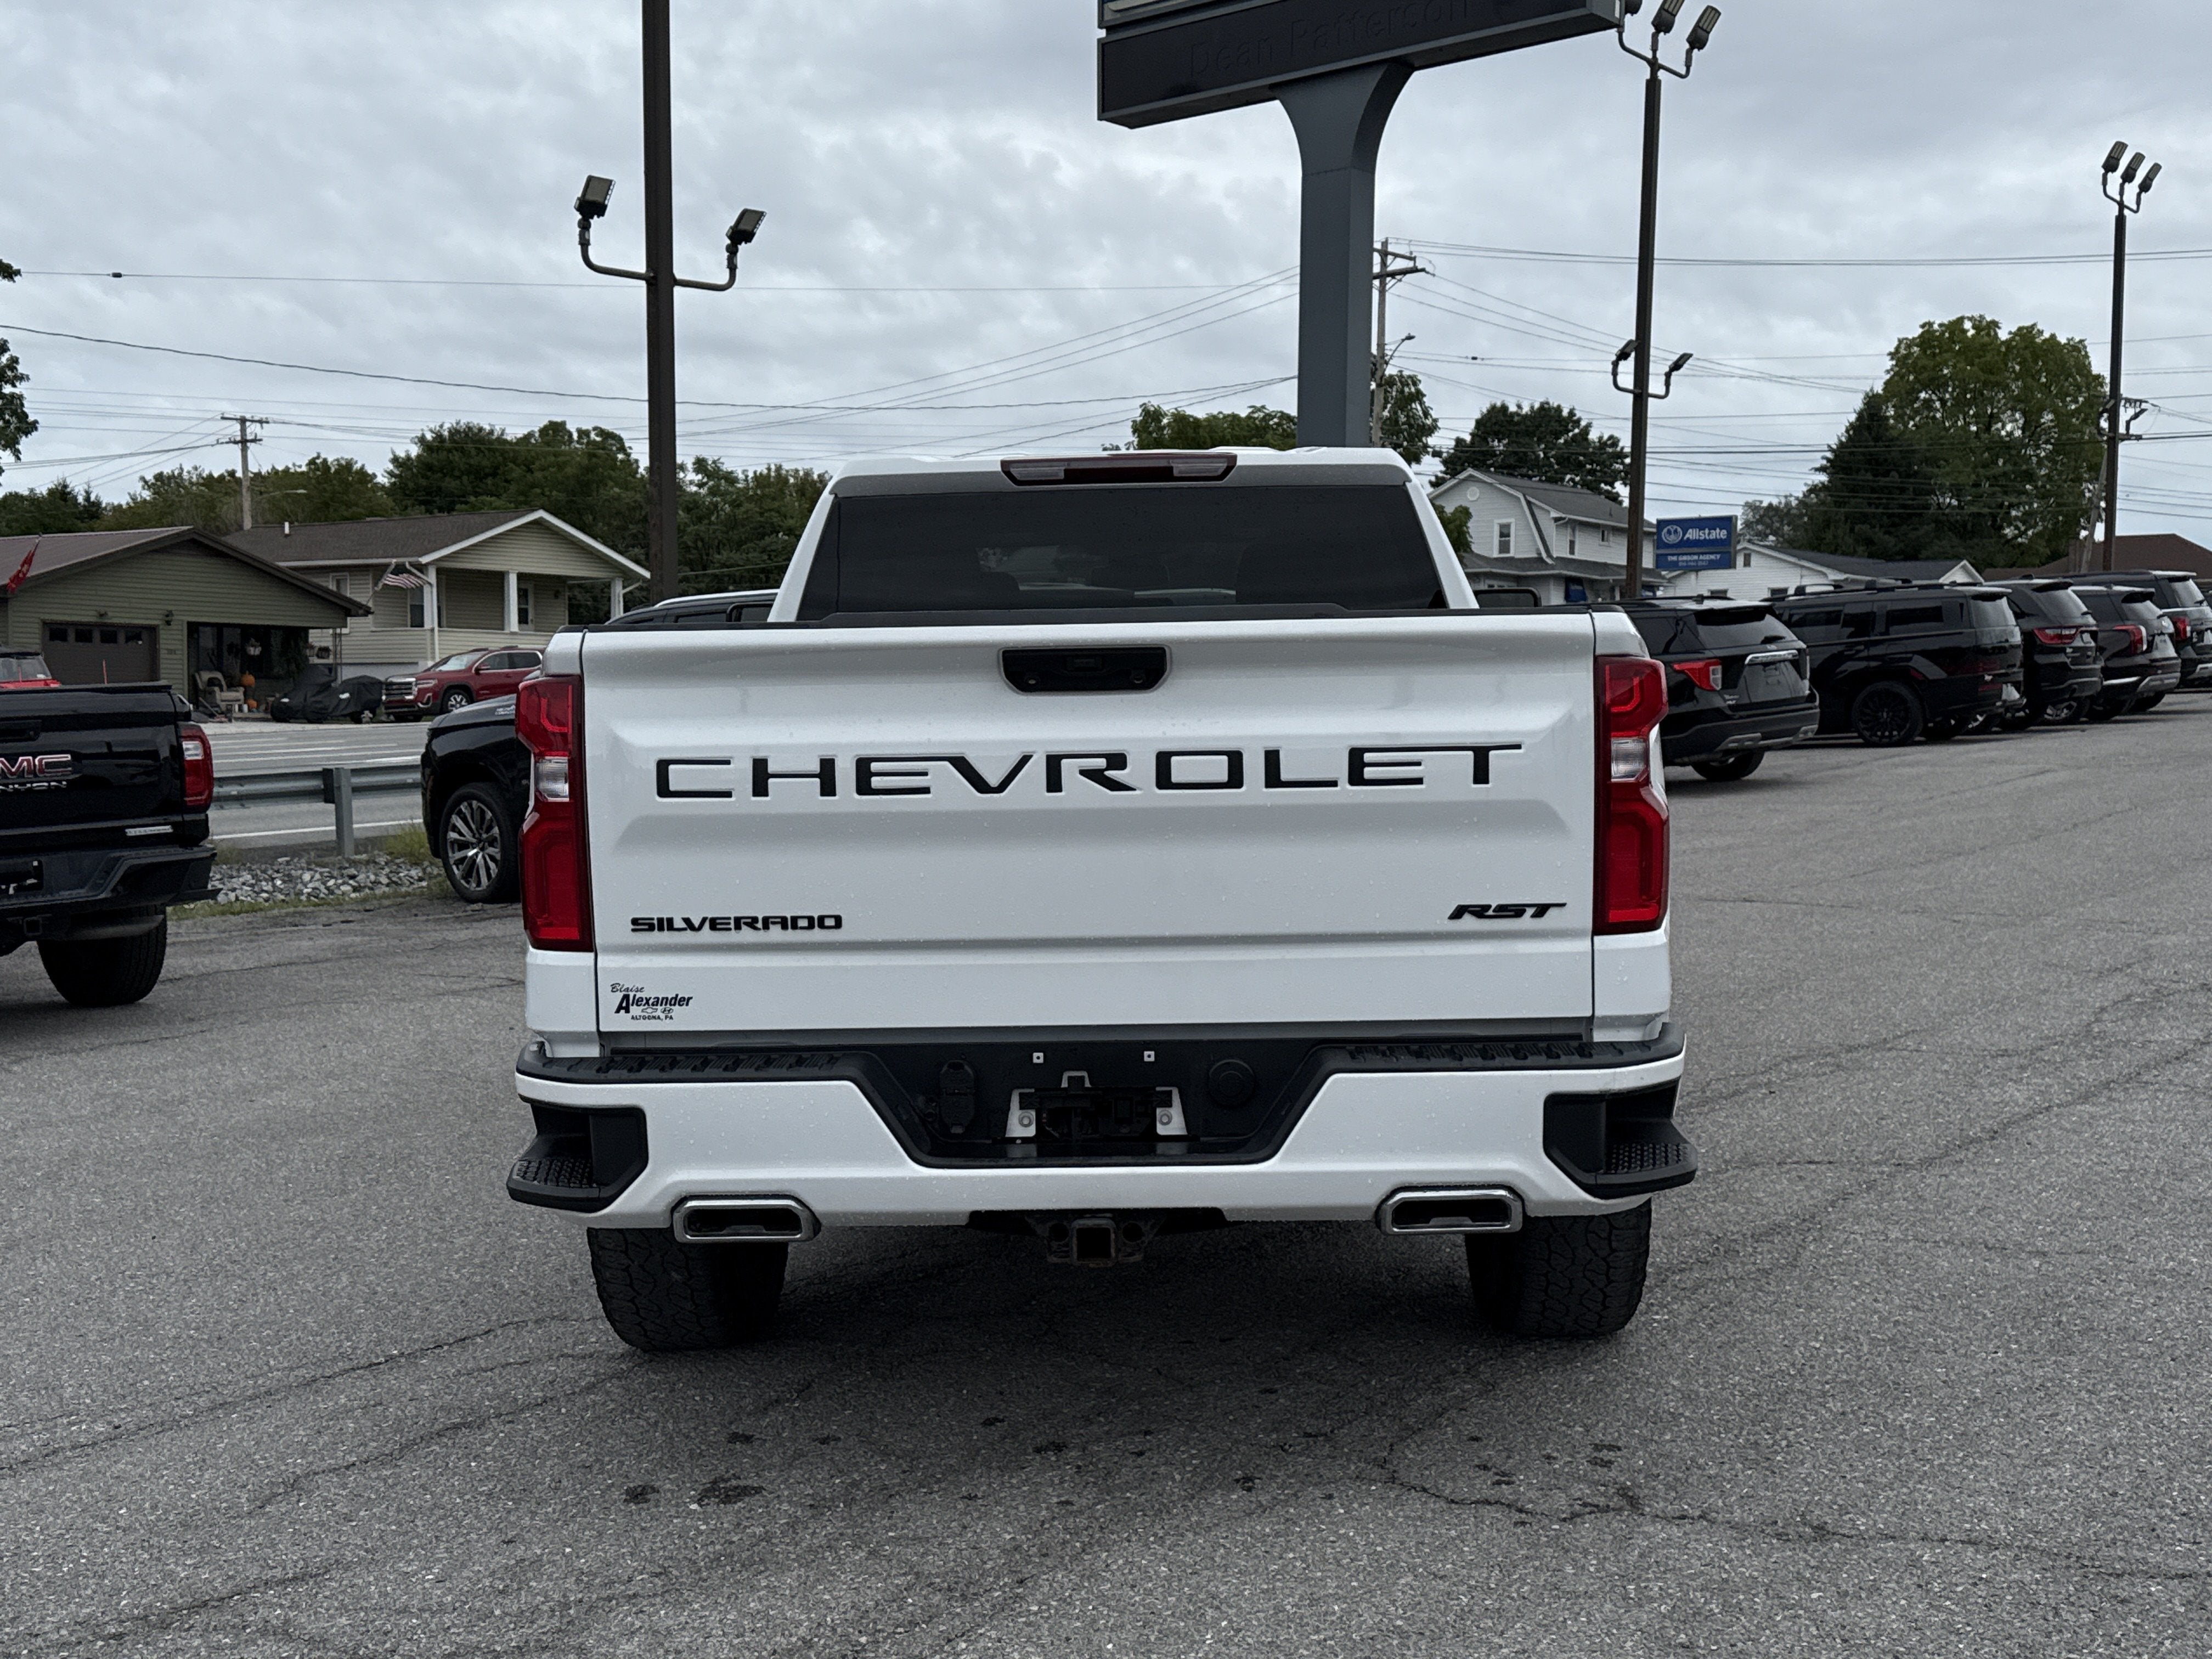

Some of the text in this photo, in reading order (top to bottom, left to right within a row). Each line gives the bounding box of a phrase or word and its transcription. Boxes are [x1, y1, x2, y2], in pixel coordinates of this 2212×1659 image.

[1190, 36, 1274, 78] Dean
[1684, 527, 1728, 540] Allstate
[656, 743, 1522, 798] CHEVROLET
[1448, 902, 1567, 920] RST
[630, 915, 843, 932] SILVERADO
[610, 983, 645, 993] Blaise
[614, 994, 693, 1014] Alexander
